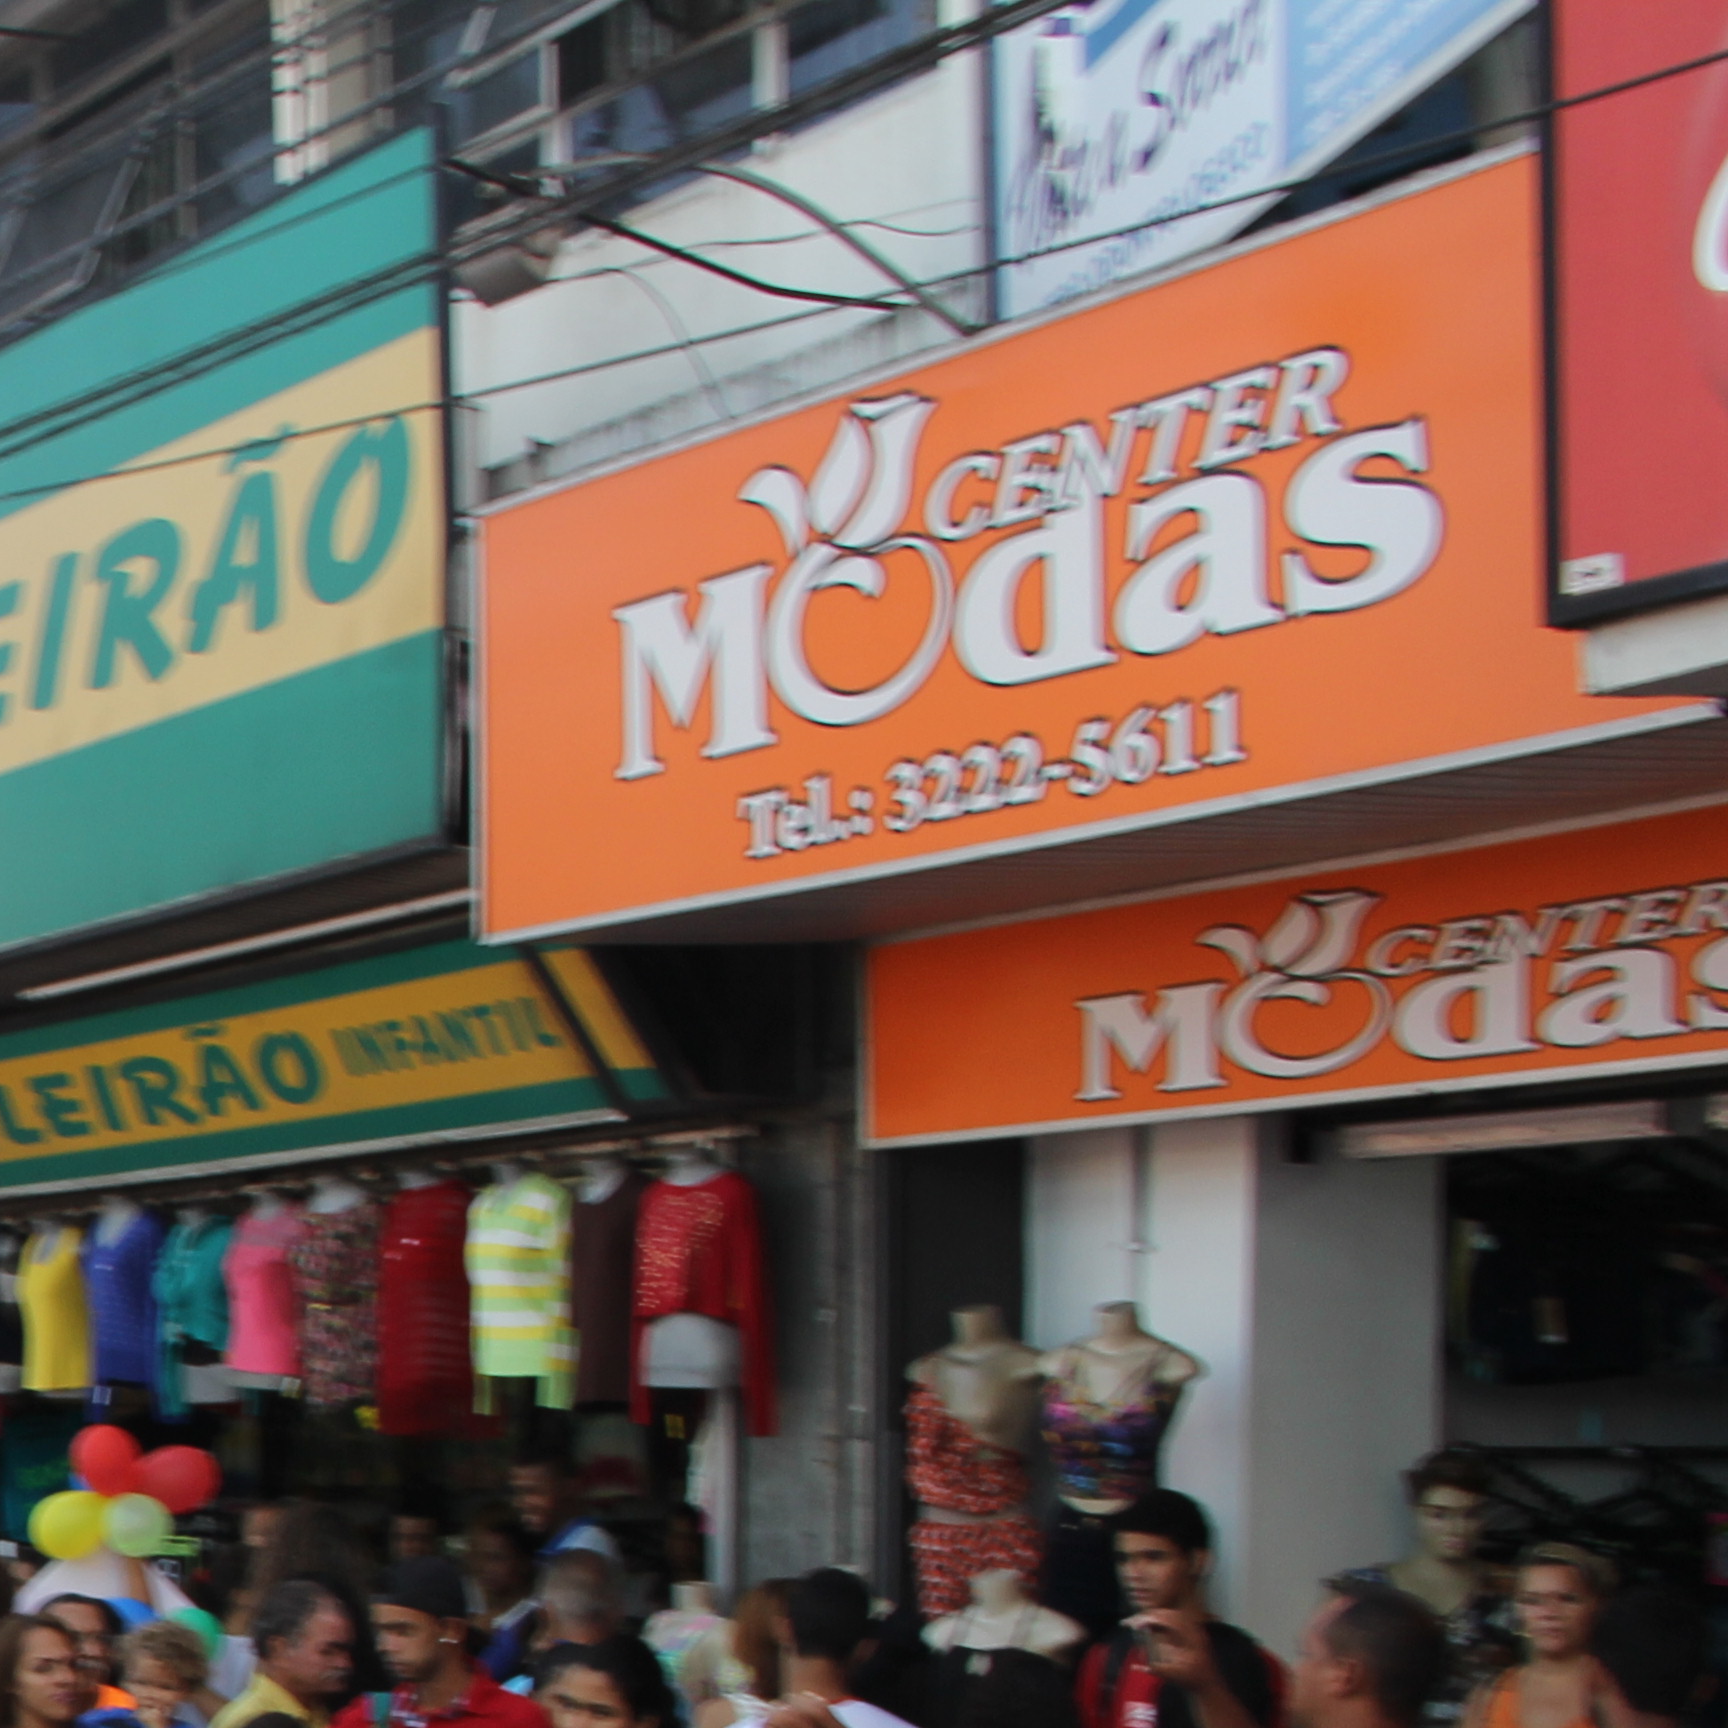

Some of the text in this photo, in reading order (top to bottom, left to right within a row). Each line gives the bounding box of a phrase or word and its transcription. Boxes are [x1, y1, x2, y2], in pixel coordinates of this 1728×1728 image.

[924, 345, 1350, 542] CENTER
[883, 686, 1248, 835] 3222-5611
[329, 995, 564, 1078] INFANTIL
[1074, 935, 1728, 1102] Moda
